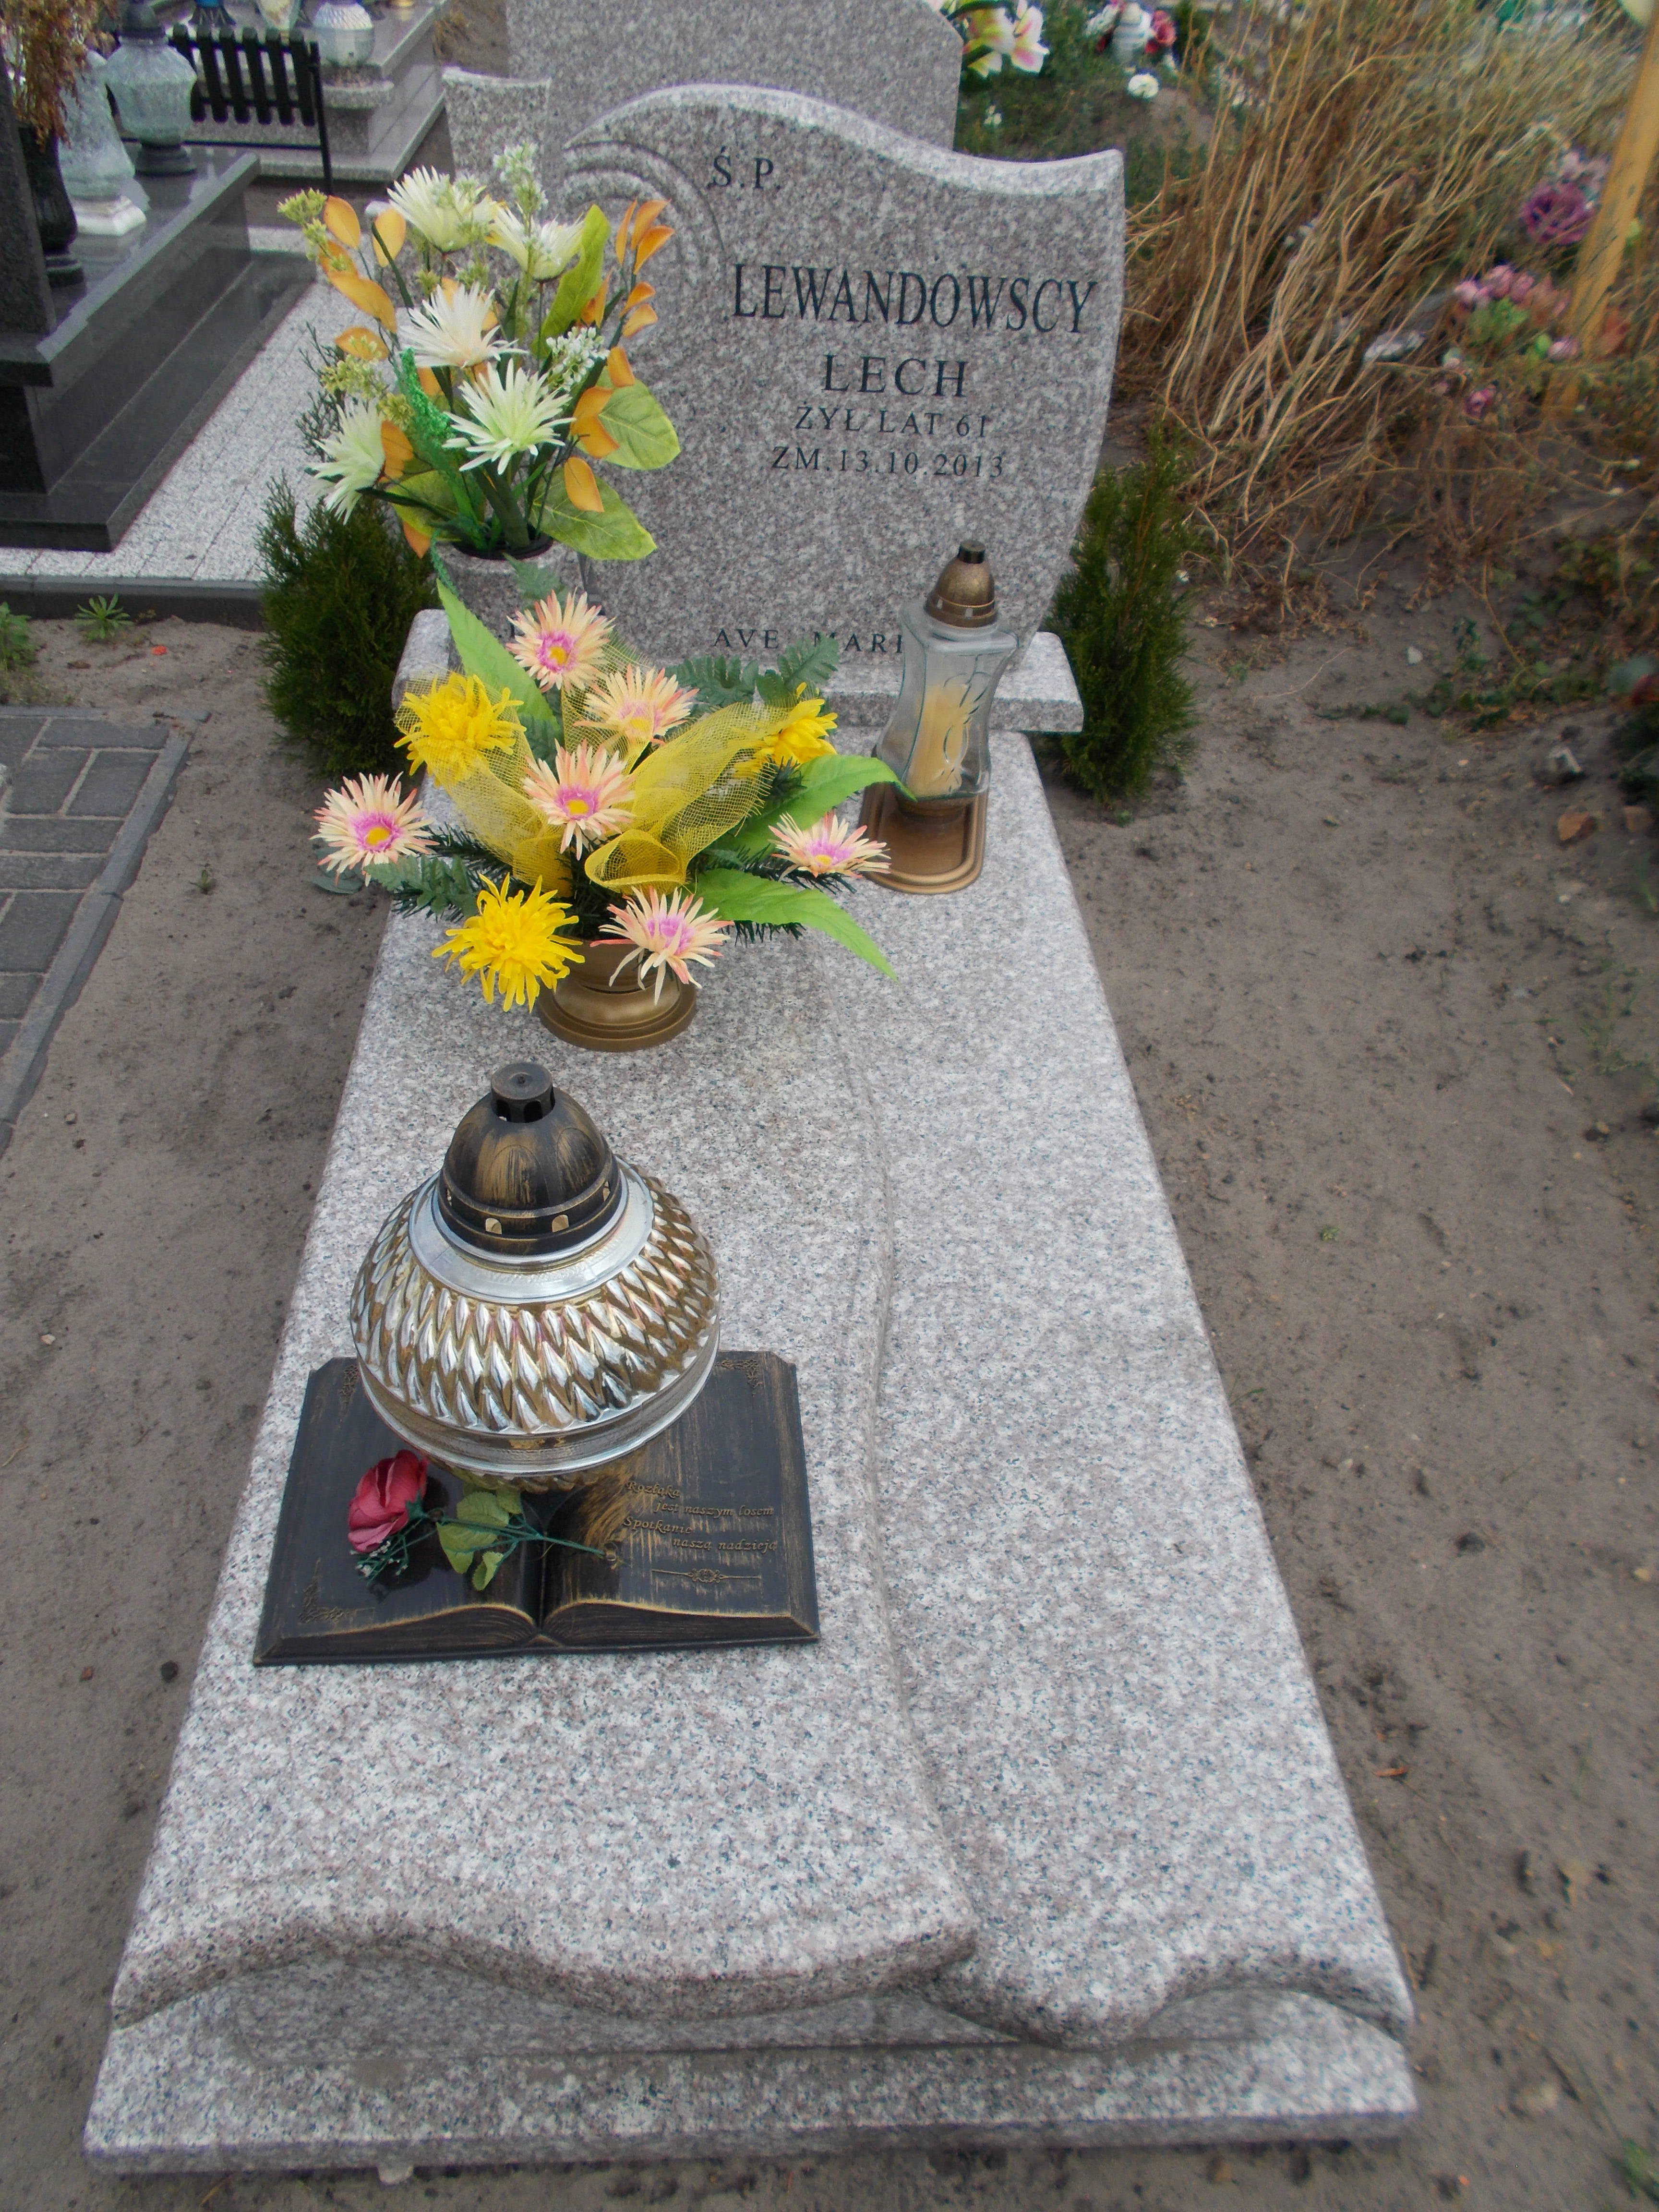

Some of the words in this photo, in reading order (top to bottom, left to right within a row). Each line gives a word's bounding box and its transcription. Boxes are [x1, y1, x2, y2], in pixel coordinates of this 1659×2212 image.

[732, 263, 1097, 334] LEWANDOWSCY
[823, 354, 969, 397] LECH
[795, 400, 861, 431] ŻYŁ
[878, 409, 942, 435] LAT
[956, 414, 986, 438] 61
[713, 628, 779, 649] AVE
[626, 1480, 680, 1498] Rozłąka
[654, 1501, 679, 1513] jest
[684, 1504, 733, 1518] naszym
[739, 1505, 774, 1516] losem
[623, 1516, 693, 1534] Spotkanie
[673, 1536, 712, 1551] naszą
[718, 1539, 778, 1554] nadzieją
